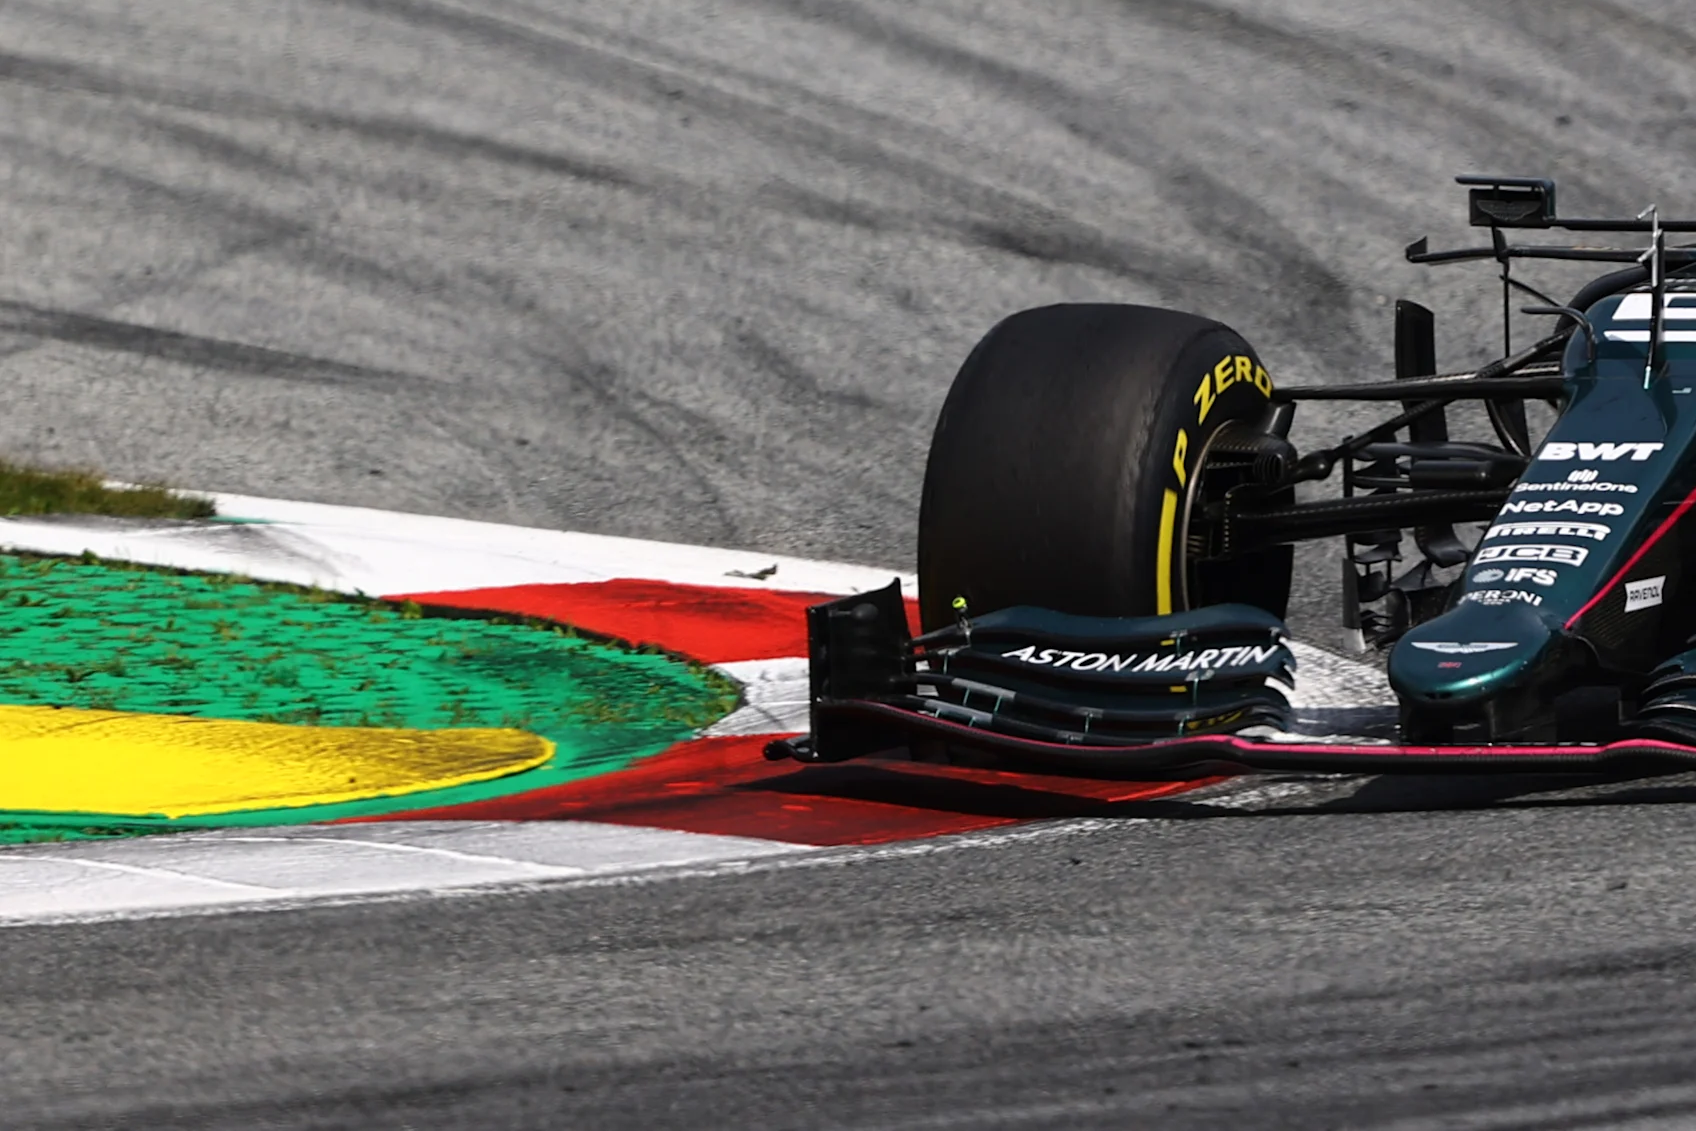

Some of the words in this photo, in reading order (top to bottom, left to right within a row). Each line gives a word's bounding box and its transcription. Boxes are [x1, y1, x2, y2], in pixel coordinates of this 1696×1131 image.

[1193, 355, 1273, 426] ZERO
[1538, 443, 1664, 461] BWT
[1514, 482, 1639, 494] SentinelOne
[1499, 499, 1625, 516] NetApp
[1483, 521, 1612, 541] PIRELLI
[1475, 545, 1588, 566] JCB
[1504, 568, 1558, 586] IFS
[1457, 589, 1543, 607] PERONI
[1001, 645, 1131, 672] ASTON
[1131, 645, 1278, 672] MARTIN
